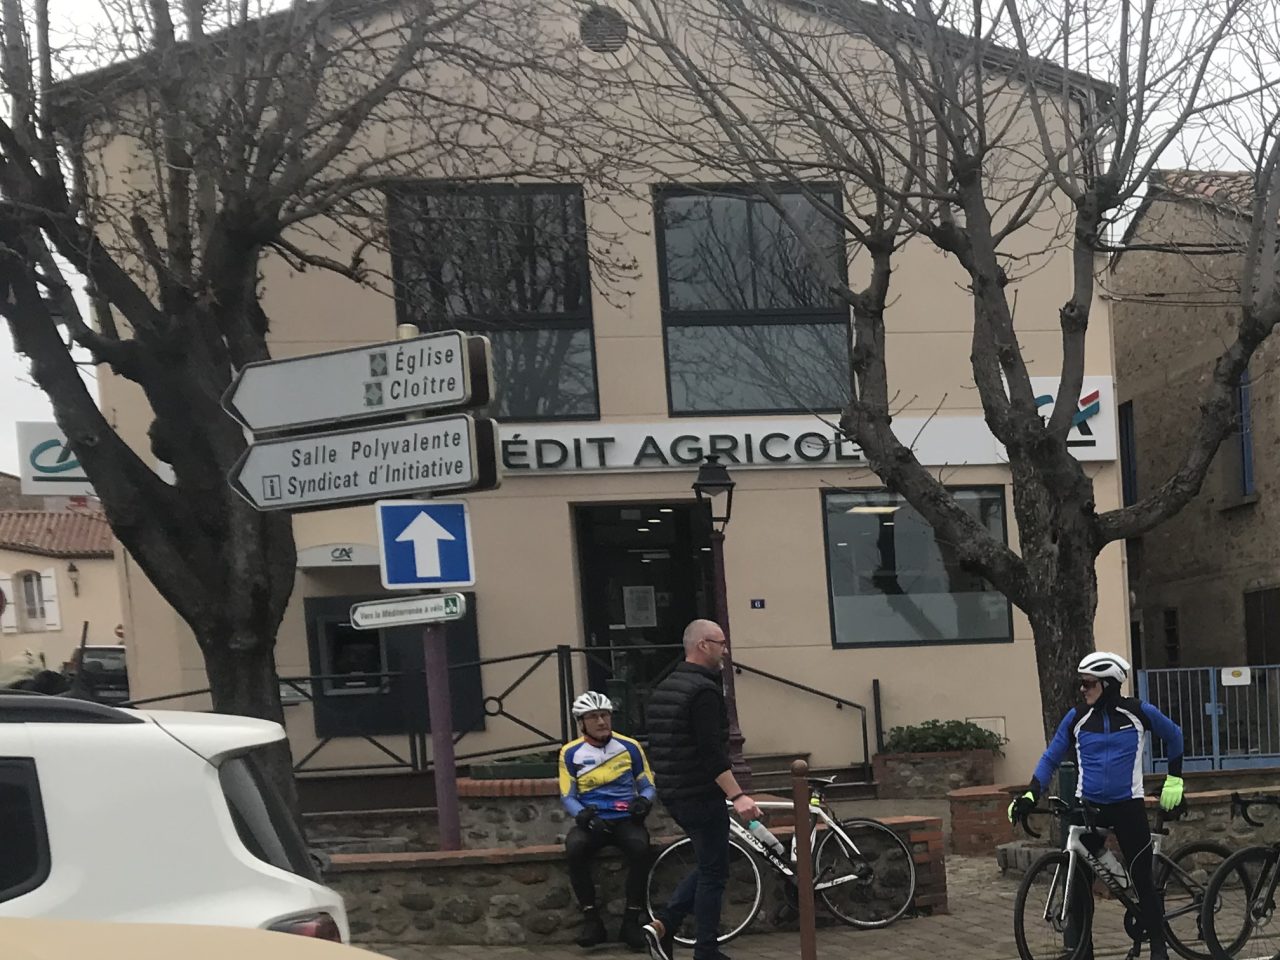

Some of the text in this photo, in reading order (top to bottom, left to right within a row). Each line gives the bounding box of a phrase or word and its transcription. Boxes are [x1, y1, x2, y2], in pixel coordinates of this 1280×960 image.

[395, 347, 454, 374] Église
[390, 376, 456, 400] Cloître
[291, 431, 461, 467] Salle Polyvalente
[287, 458, 464, 498] Syndicat d'Initiative
